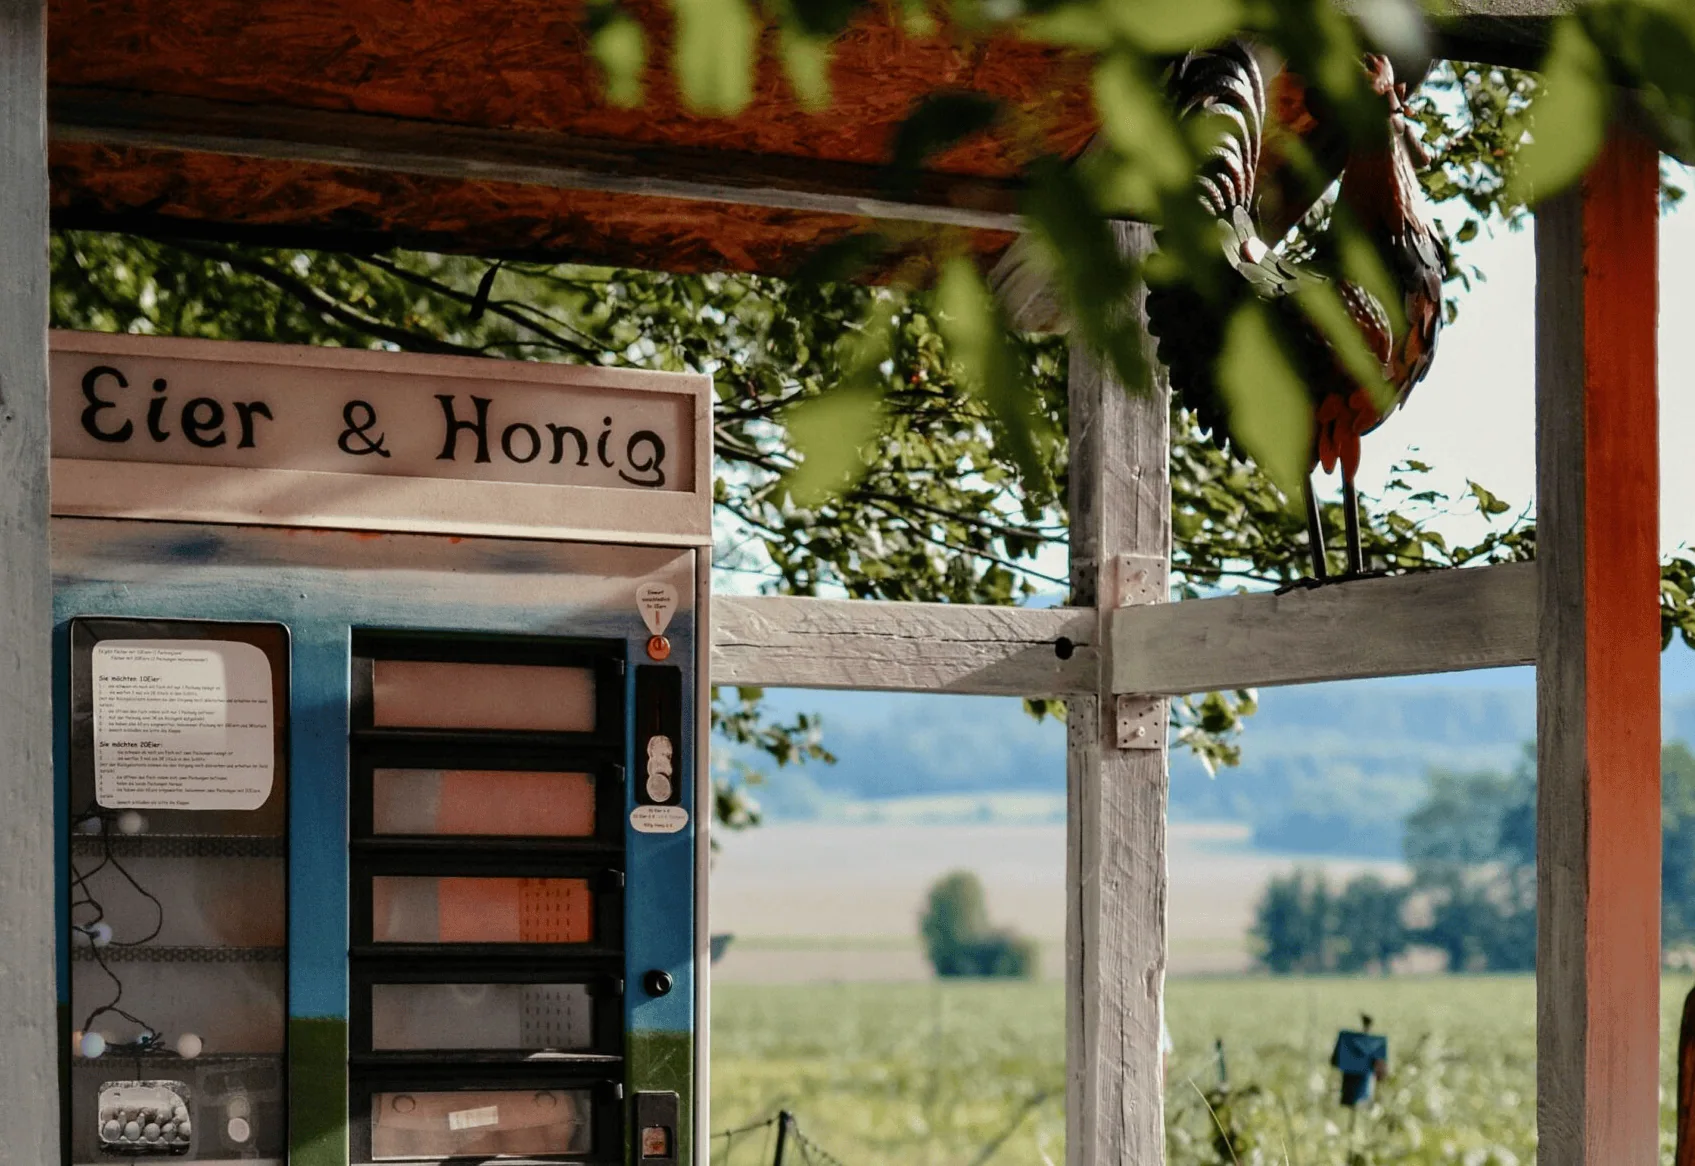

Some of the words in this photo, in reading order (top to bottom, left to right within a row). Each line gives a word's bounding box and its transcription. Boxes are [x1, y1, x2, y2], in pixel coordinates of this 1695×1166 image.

[80, 365, 274, 449] Eier
[337, 399, 391, 458] &
[434, 394, 667, 488] Honig
